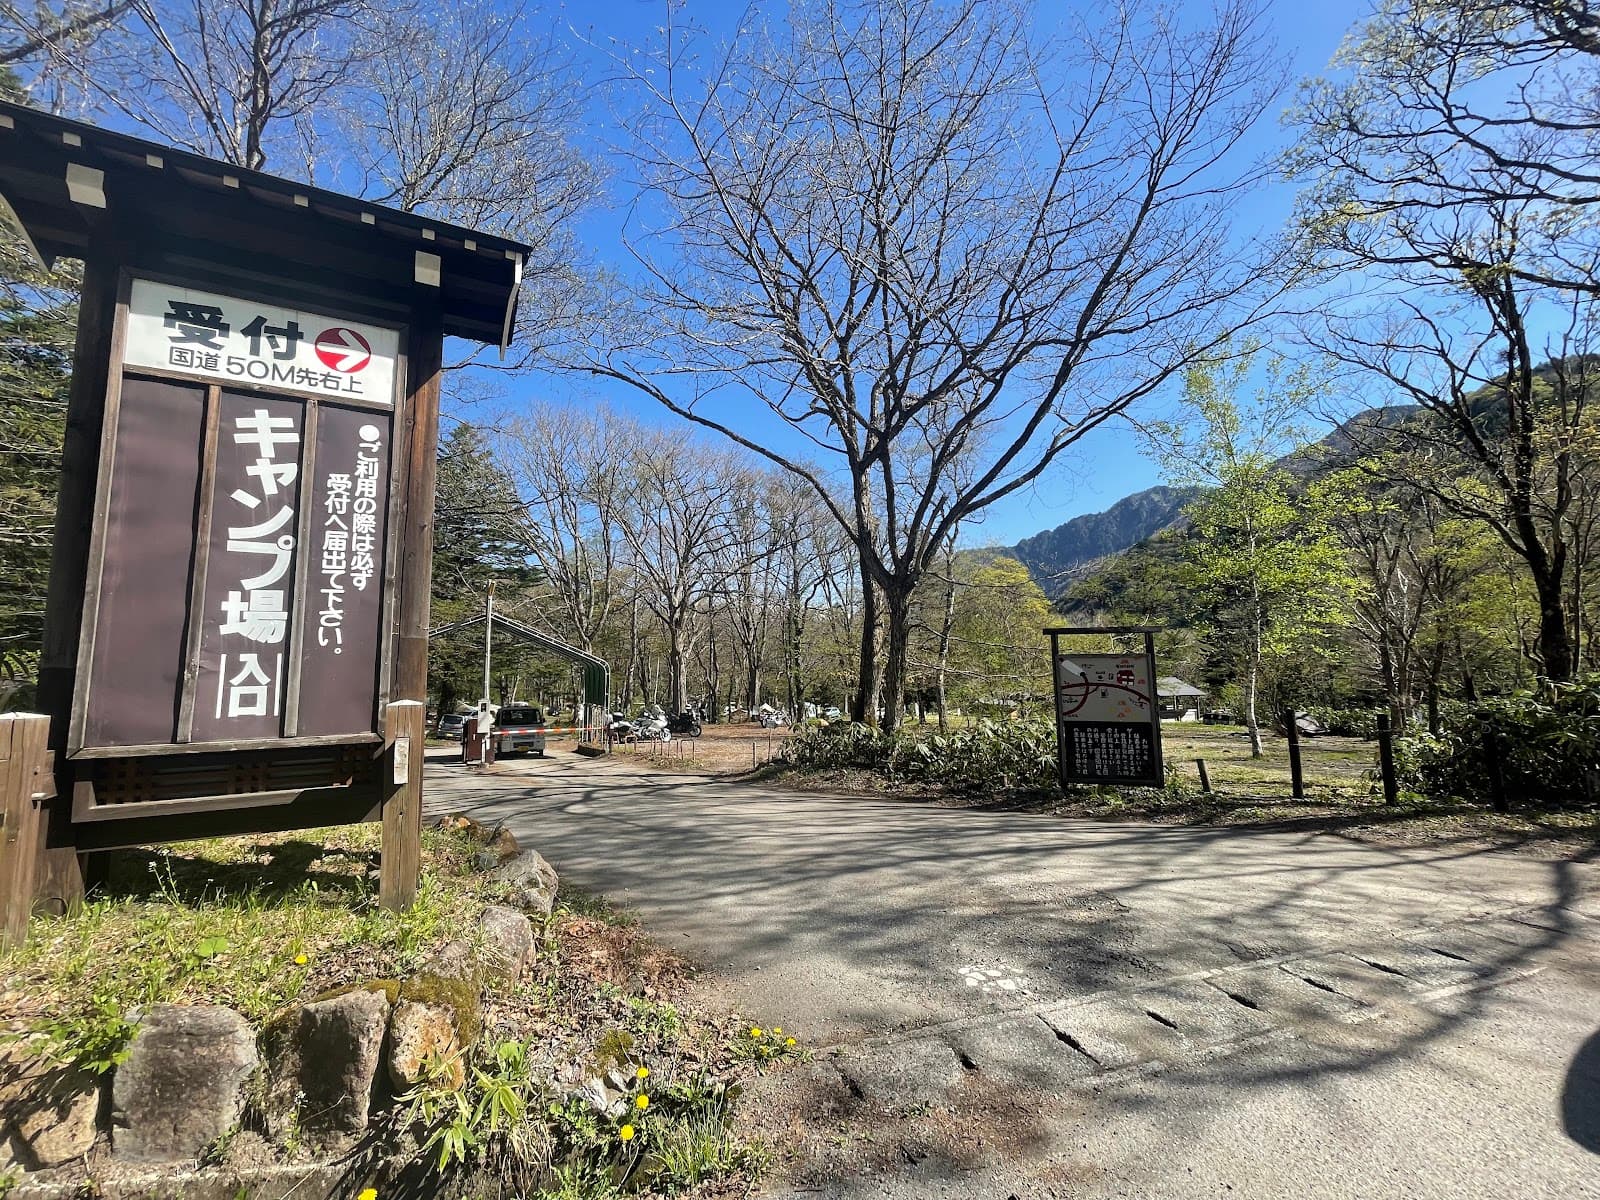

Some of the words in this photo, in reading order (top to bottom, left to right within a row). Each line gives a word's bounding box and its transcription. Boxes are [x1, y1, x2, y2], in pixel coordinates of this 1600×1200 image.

[164, 300, 304, 360] 受付
[318, 473, 352, 655] 受付へ届出て下さい。
[350, 441, 382, 591] ご利用の際は必ず
